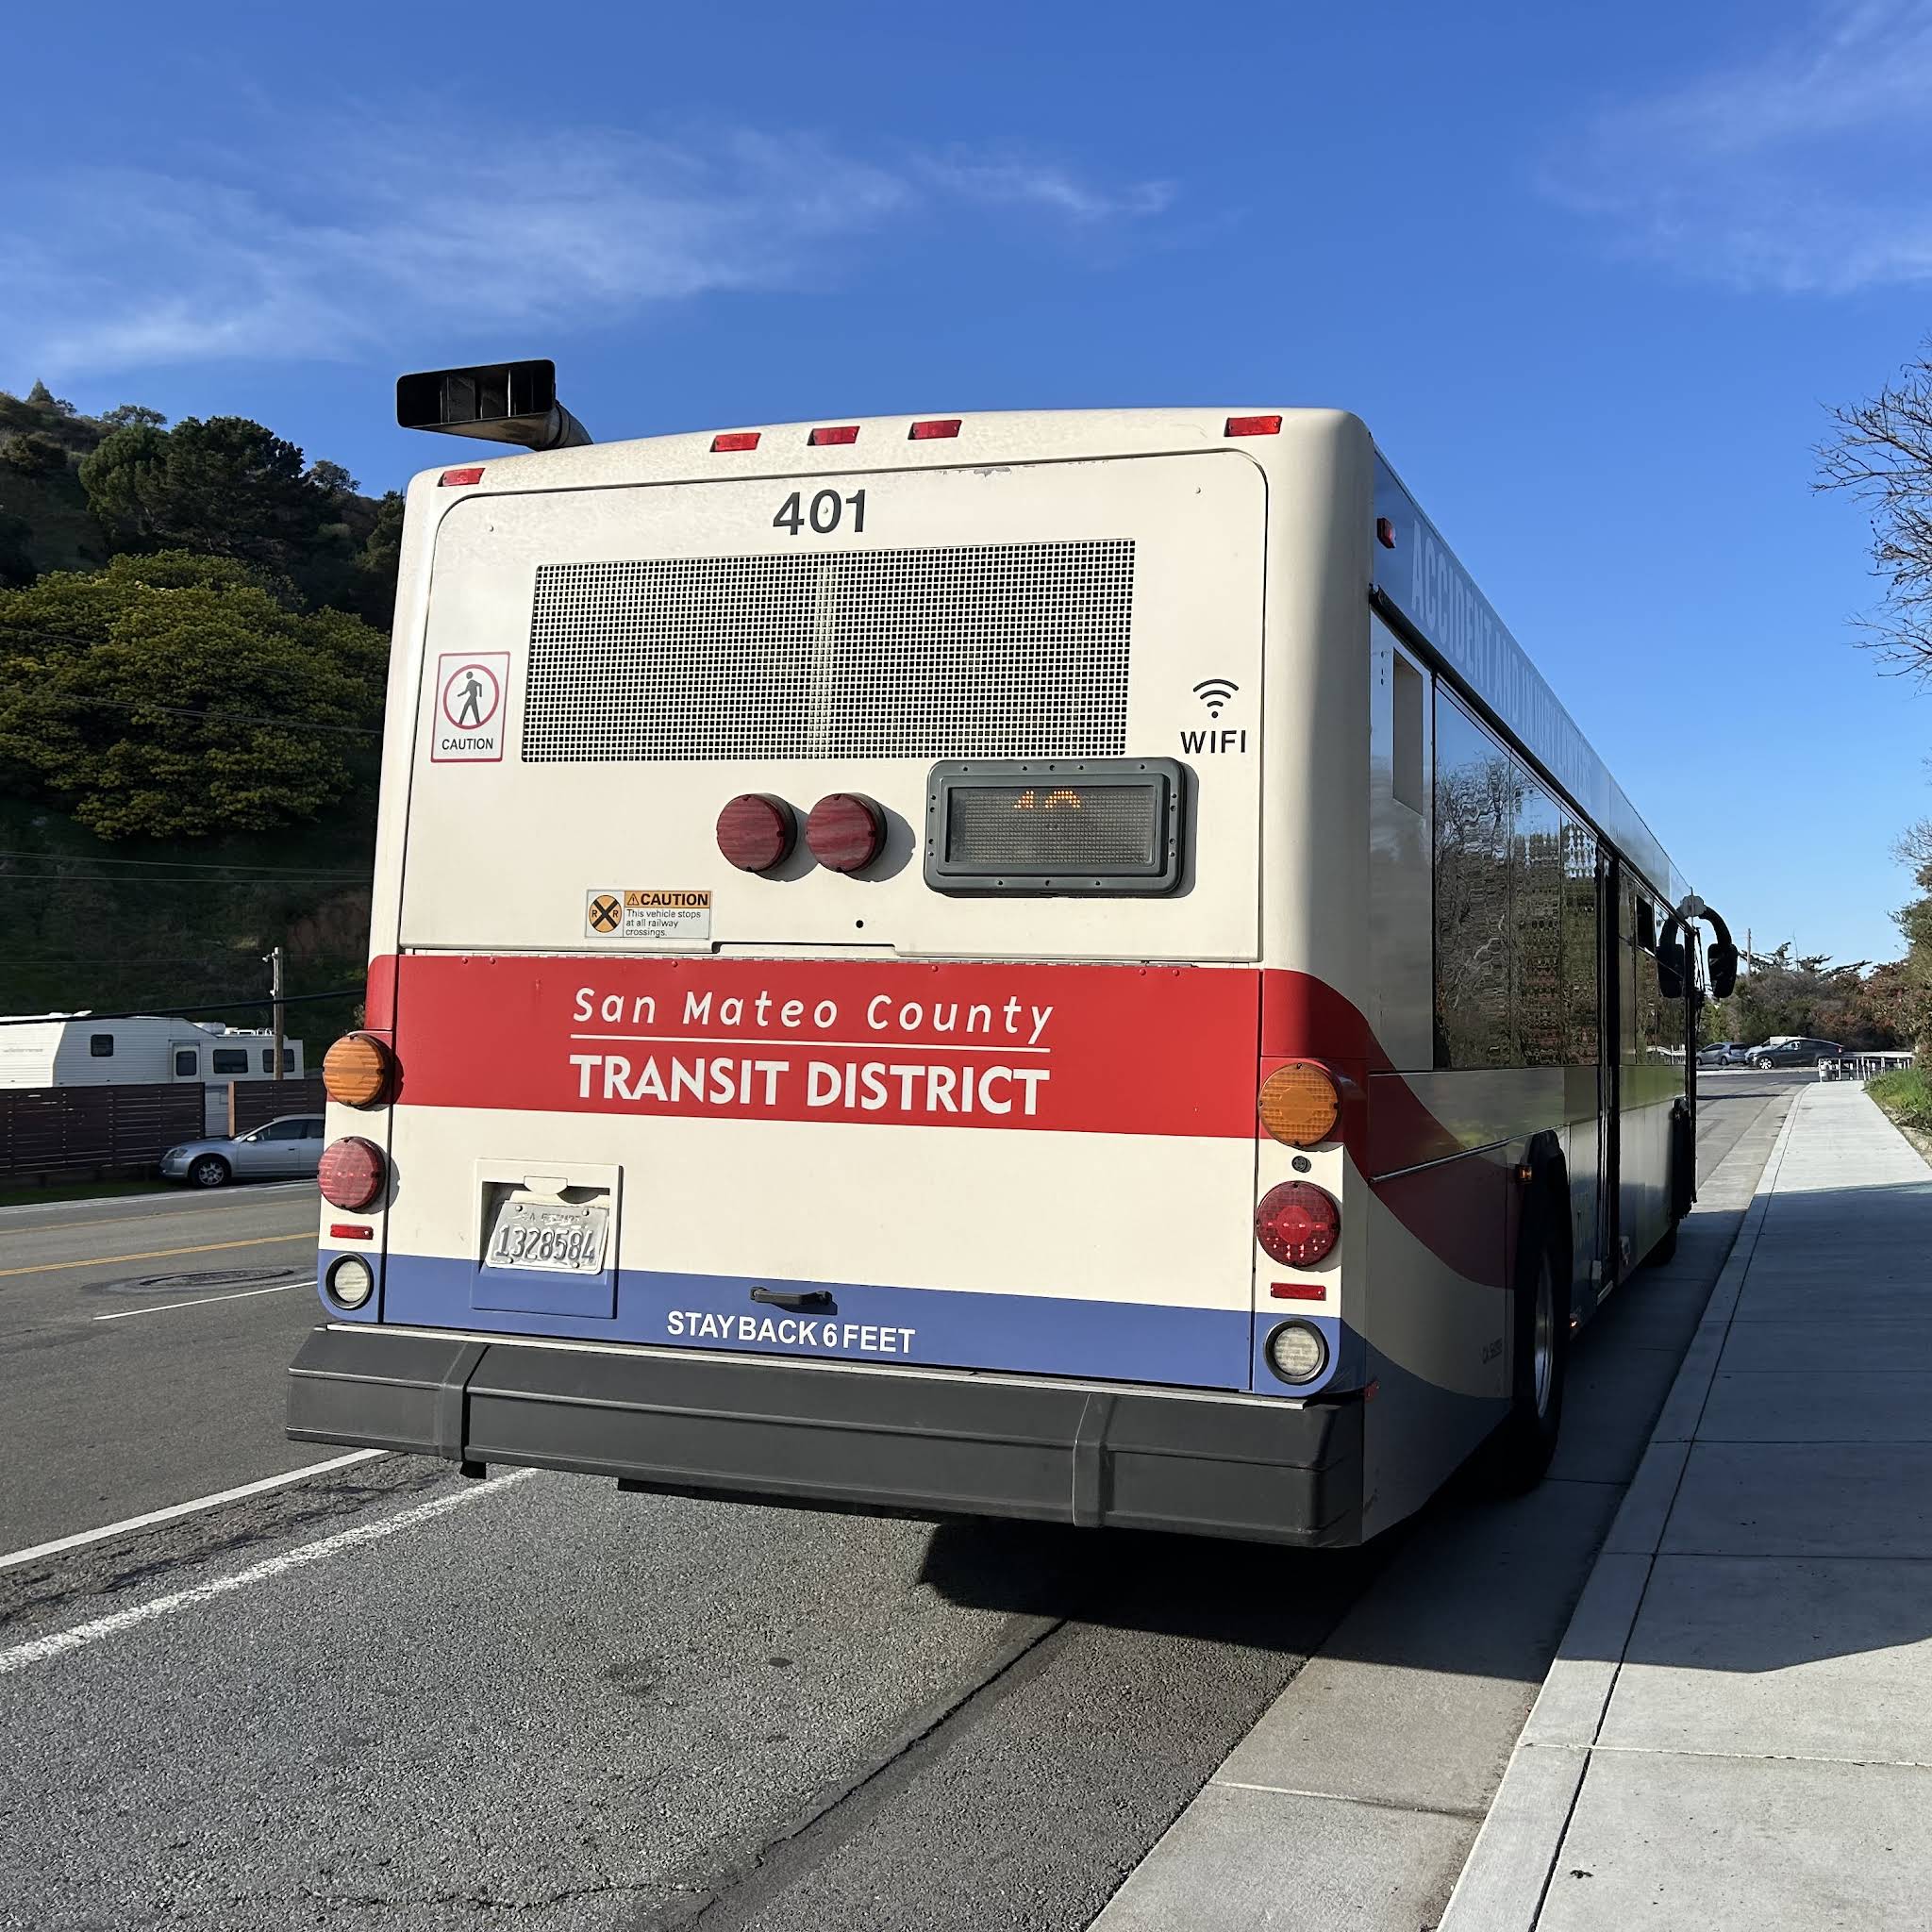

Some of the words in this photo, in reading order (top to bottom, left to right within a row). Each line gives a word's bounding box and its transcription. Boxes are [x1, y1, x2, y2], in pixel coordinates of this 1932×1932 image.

[773, 489, 866, 536] 401
[1411, 520, 1492, 694] ACCIDENT
[1494, 630, 1519, 723] AND
[441, 738, 493, 751] CAUTION
[1180, 729, 1246, 754] WIFI
[641, 893, 708, 906] CAUTION
[591, 909, 598, 918] R
[612, 909, 619, 918] R
[627, 908, 644, 918] This
[646, 909, 676, 918] vehicle
[677, 910, 701, 920] stops
[636, 919, 646, 927] all
[648, 919, 679, 929] railway
[625, 928, 667, 938] crossings.
[573, 987, 656, 1024] San
[682, 991, 838, 1029] Mateo
[867, 994, 1054, 1045] County
[569, 1054, 790, 1106] TRANSIT
[807, 1060, 1051, 1115] DISTRICT
[494, 1224, 596, 1261] 1328584
[667, 1310, 735, 1339] STAY
[738, 1315, 817, 1346] BACK
[823, 1323, 838, 1348] 6
[842, 1324, 916, 1354] FEET
